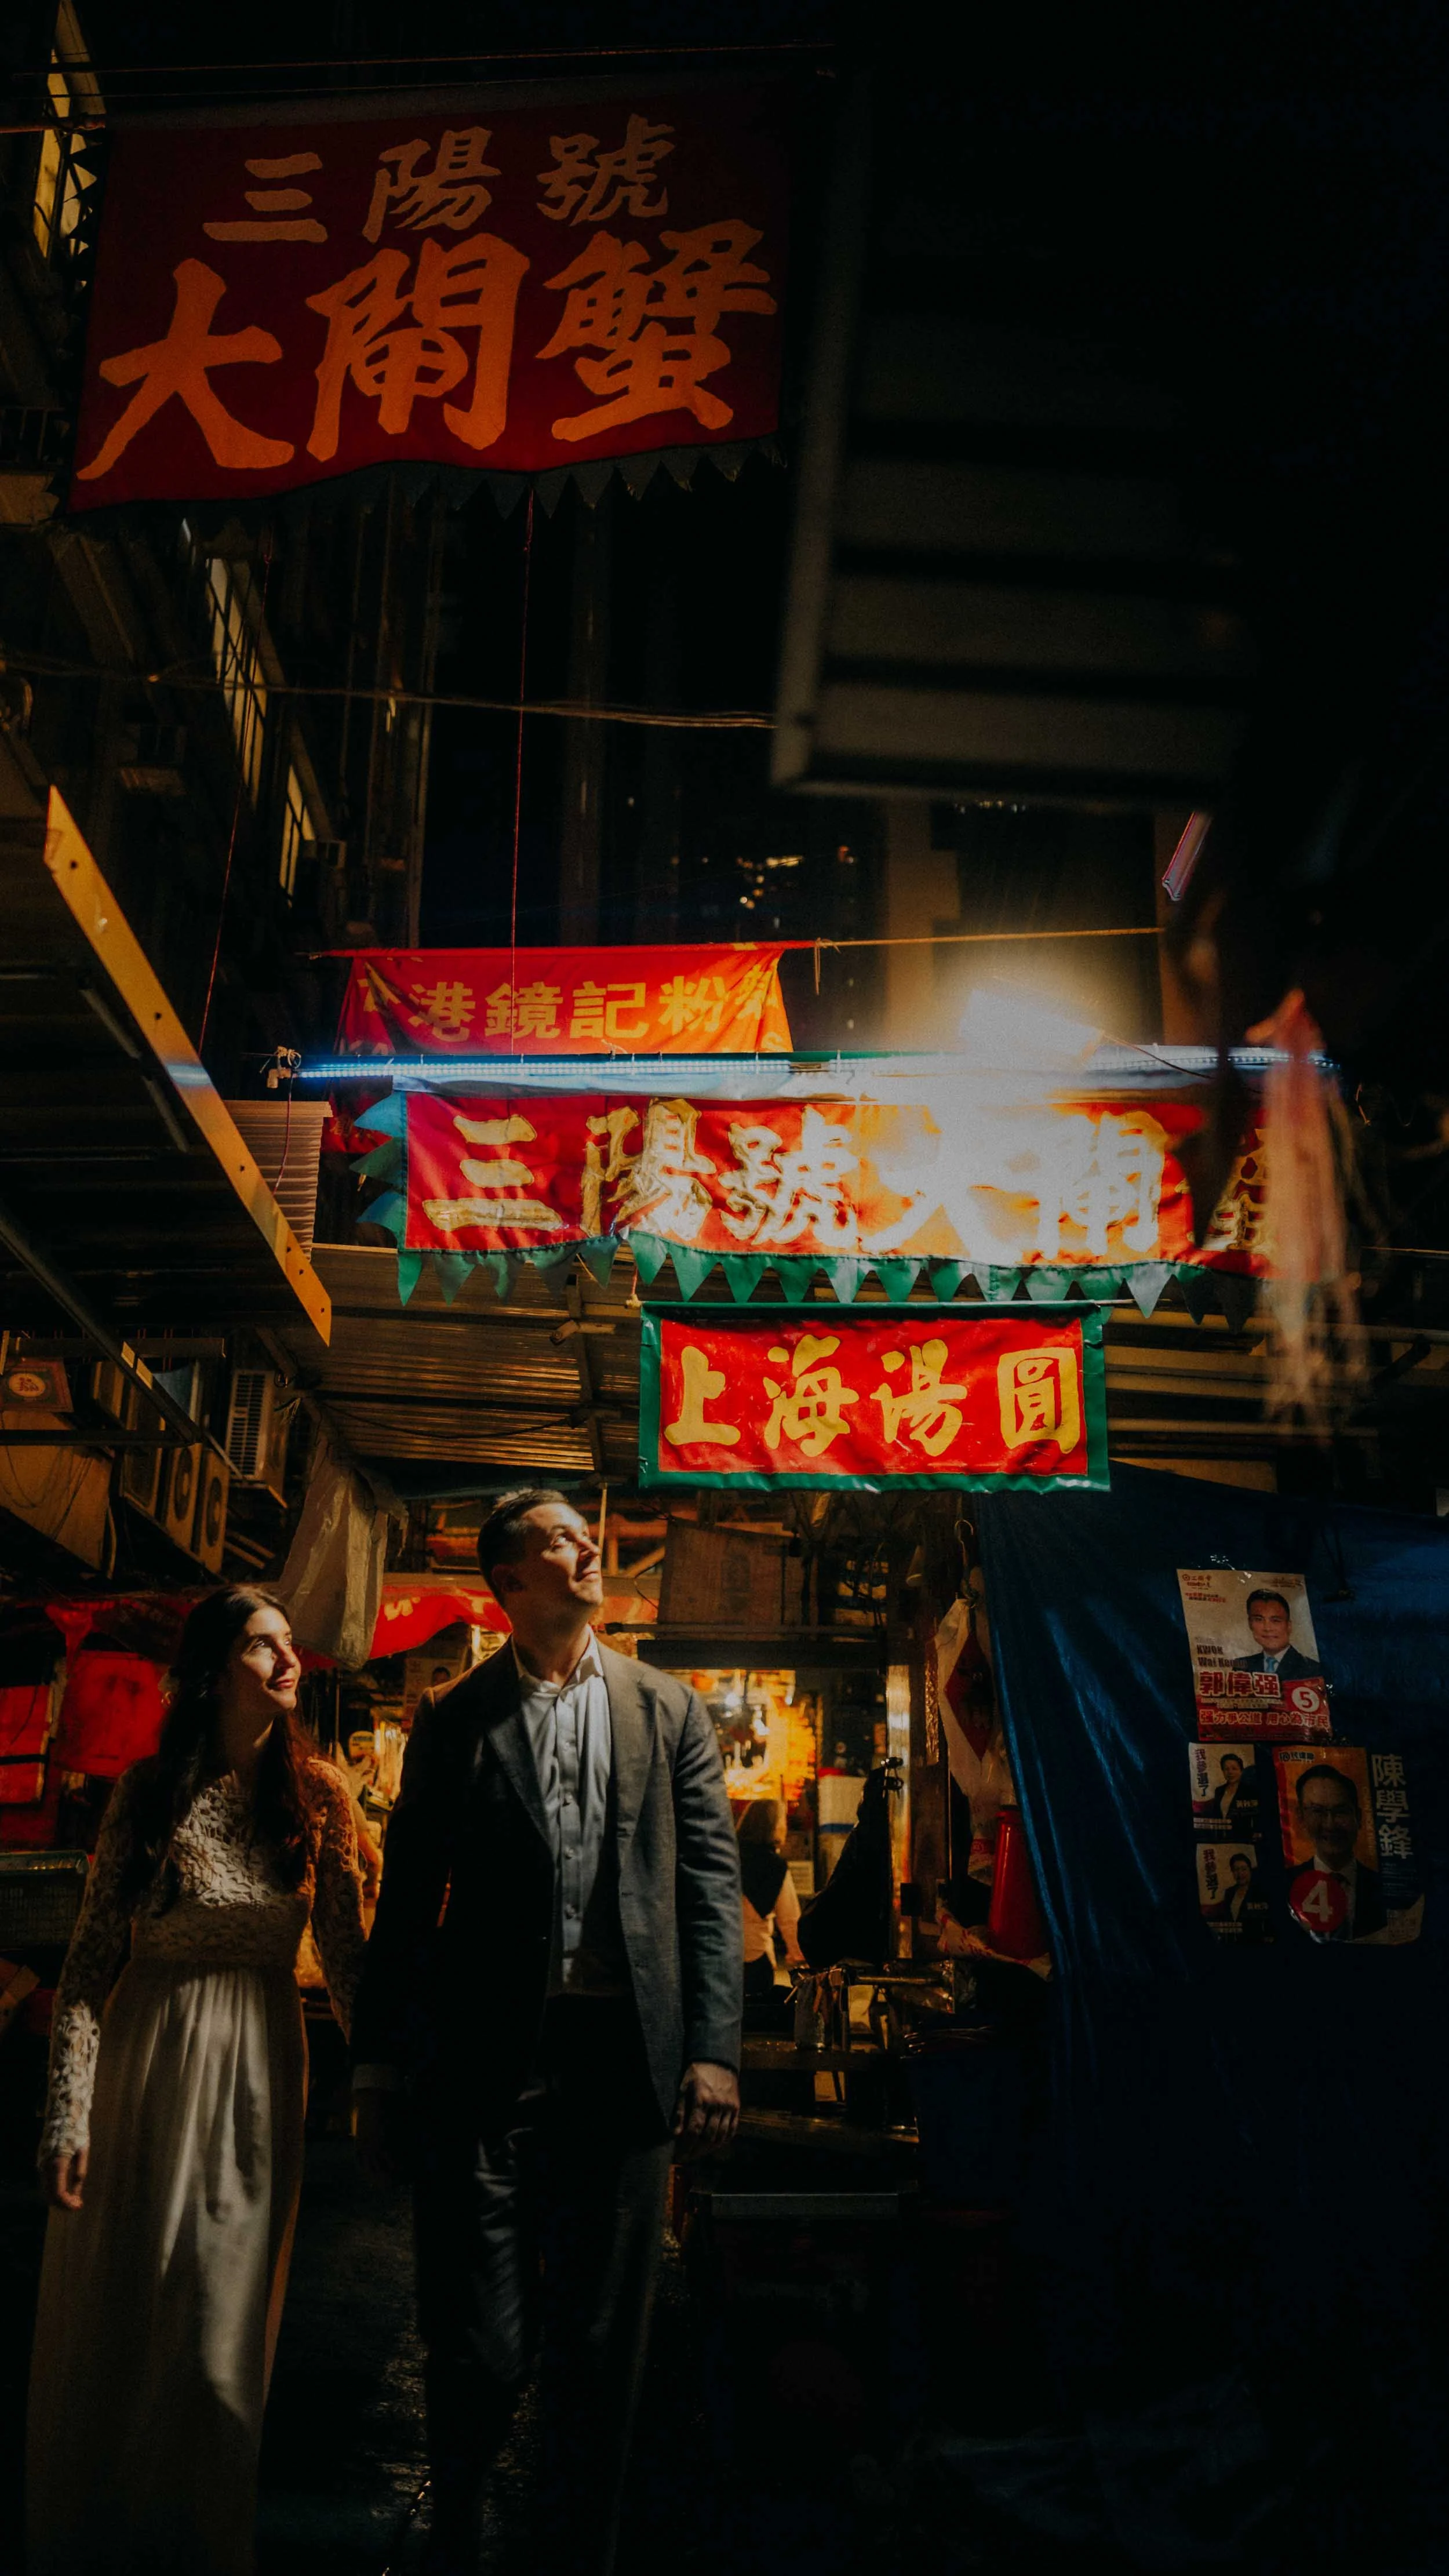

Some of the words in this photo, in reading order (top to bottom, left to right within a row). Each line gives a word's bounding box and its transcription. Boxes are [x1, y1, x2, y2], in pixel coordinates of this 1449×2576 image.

[203, 114, 676, 243] 三陽號
[75, 218, 778, 481] 大閘蟹
[664, 1334, 1080, 1457] 上海湯圓
[1298, 1691, 1315, 1708] 5
[1371, 1753, 1414, 1860] 陳學鋒
[1301, 1879, 1333, 1923] 4
